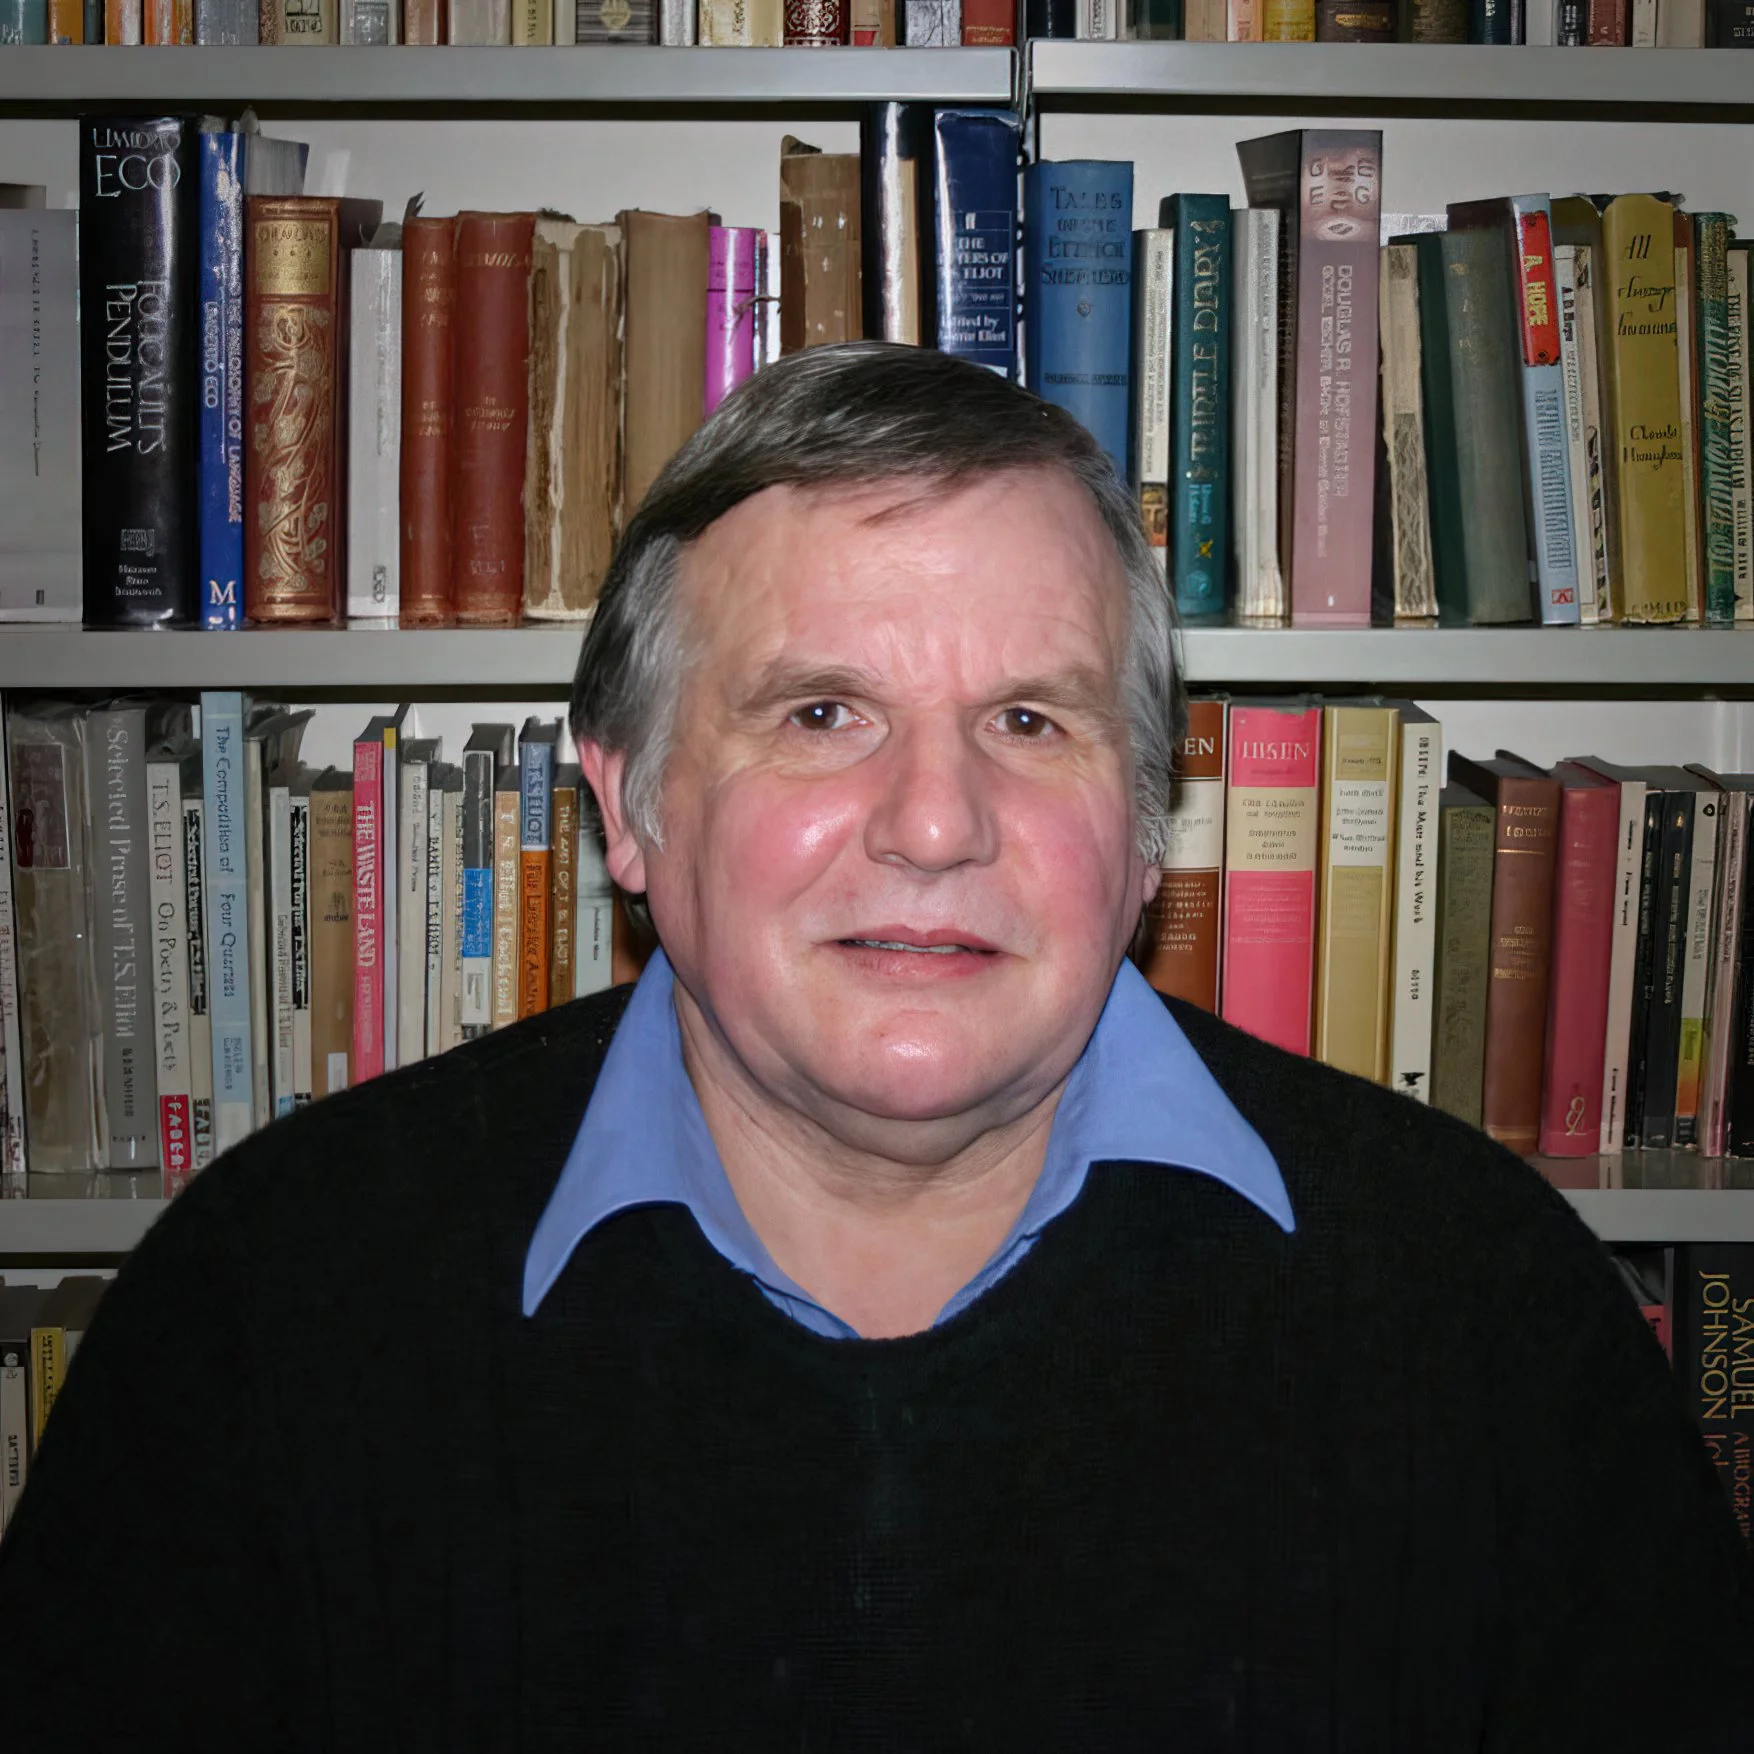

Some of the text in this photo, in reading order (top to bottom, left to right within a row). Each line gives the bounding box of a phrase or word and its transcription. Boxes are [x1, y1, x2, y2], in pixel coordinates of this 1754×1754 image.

[96, 155, 181, 197] ECO
[984, 314, 999, 330] by
[1336, 265, 1353, 354] DOUGLAS
[1528, 281, 1549, 327] HOPE
[106, 284, 138, 453] PENDULUM
[209, 580, 236, 605] M
[356, 801, 376, 840] THE
[153, 821, 172, 885] ELIOT
[356, 843, 376, 910] WASTE
[356, 913, 376, 967] LAND
[1699, 1270, 1730, 1419] JOHNSON
[1731, 1298, 1754, 1419] SAMUEL
